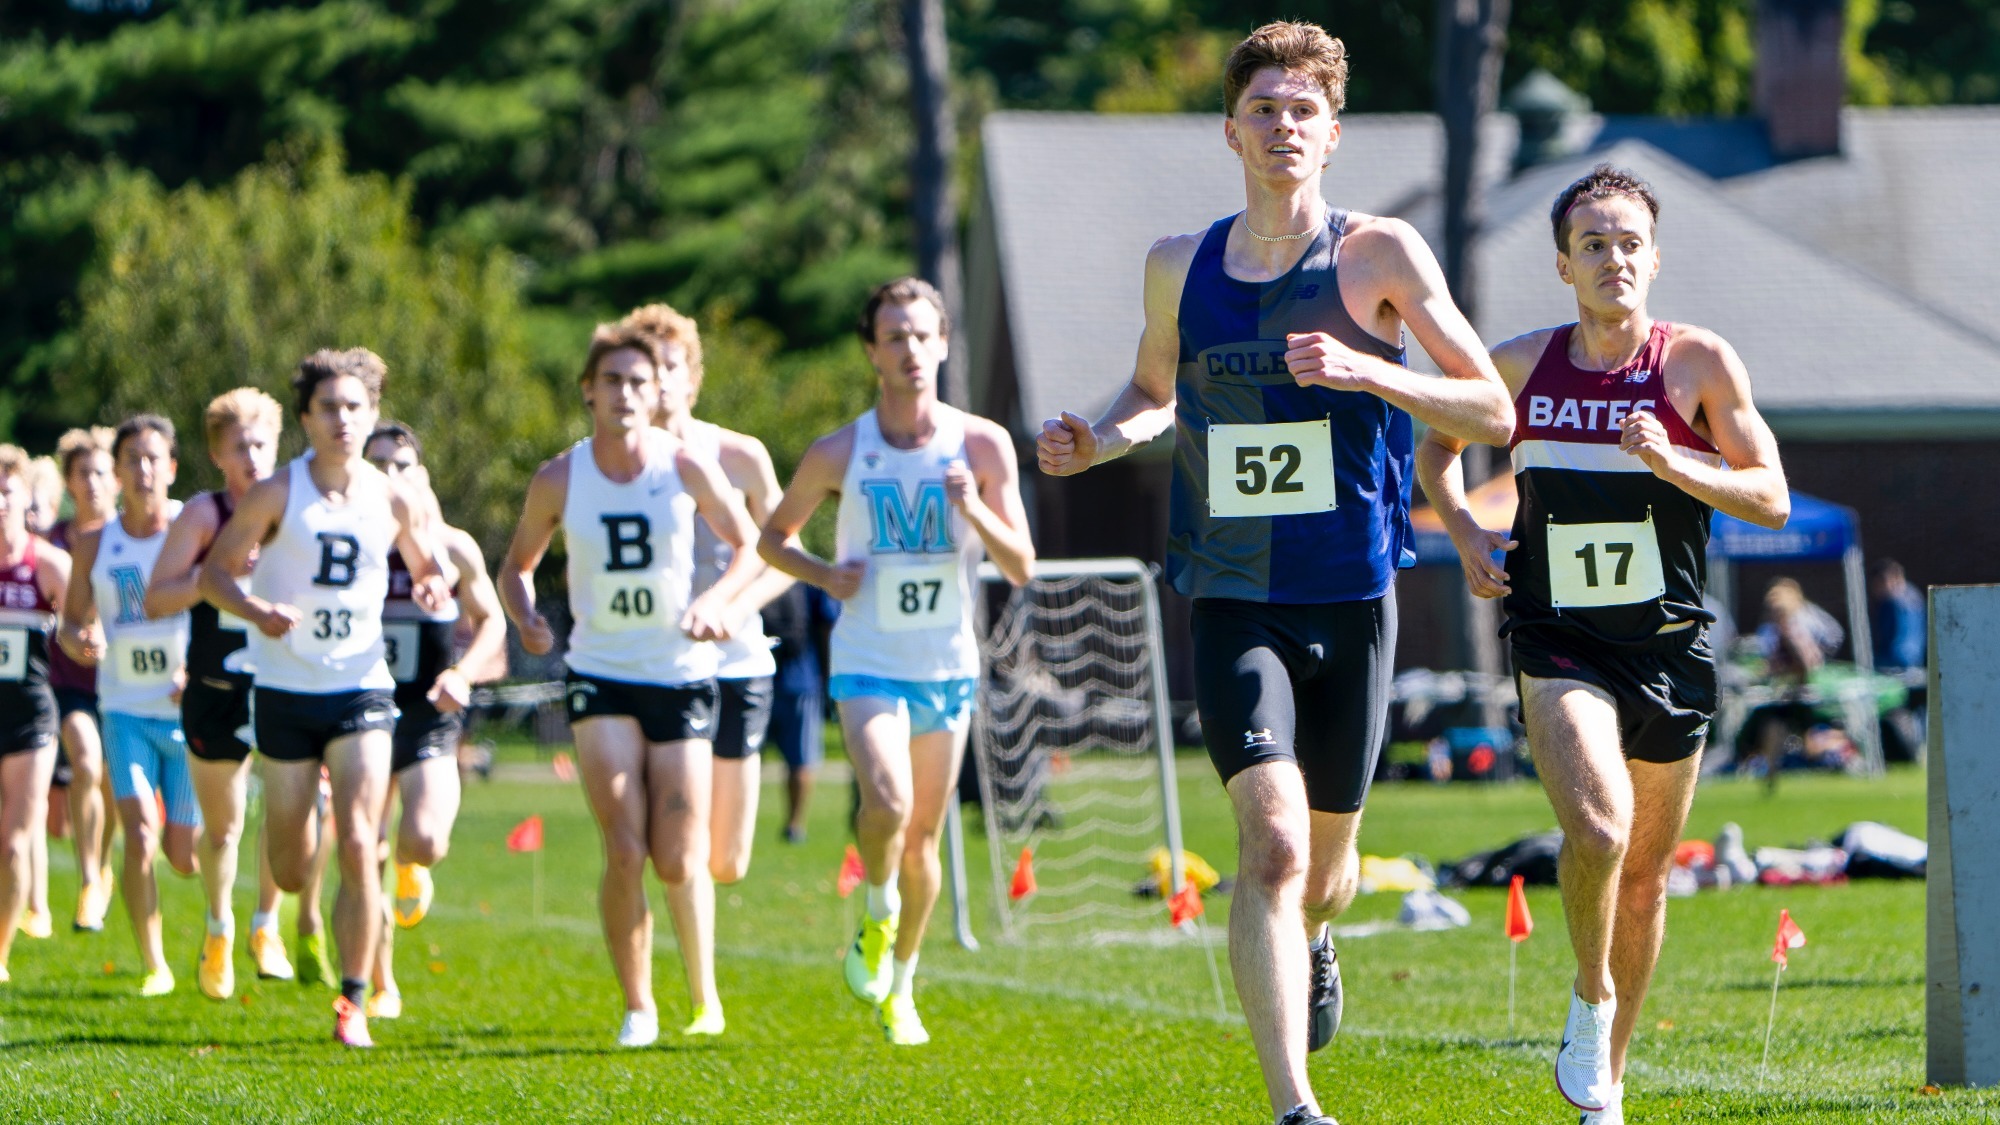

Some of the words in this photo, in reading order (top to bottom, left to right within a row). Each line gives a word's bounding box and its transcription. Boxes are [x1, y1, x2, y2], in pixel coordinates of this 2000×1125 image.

[1206, 351, 1287, 376] COLB
[1235, 444, 1304, 495] 52
[859, 478, 955, 554] M
[313, 532, 359, 586] B
[600, 513, 652, 571] B
[1575, 542, 1634, 588] 17
[0, 581, 37, 609] ES
[610, 587, 653, 616] 40
[899, 579, 942, 614] 87
[313, 608, 352, 640] 33
[131, 647, 167, 674] 89
